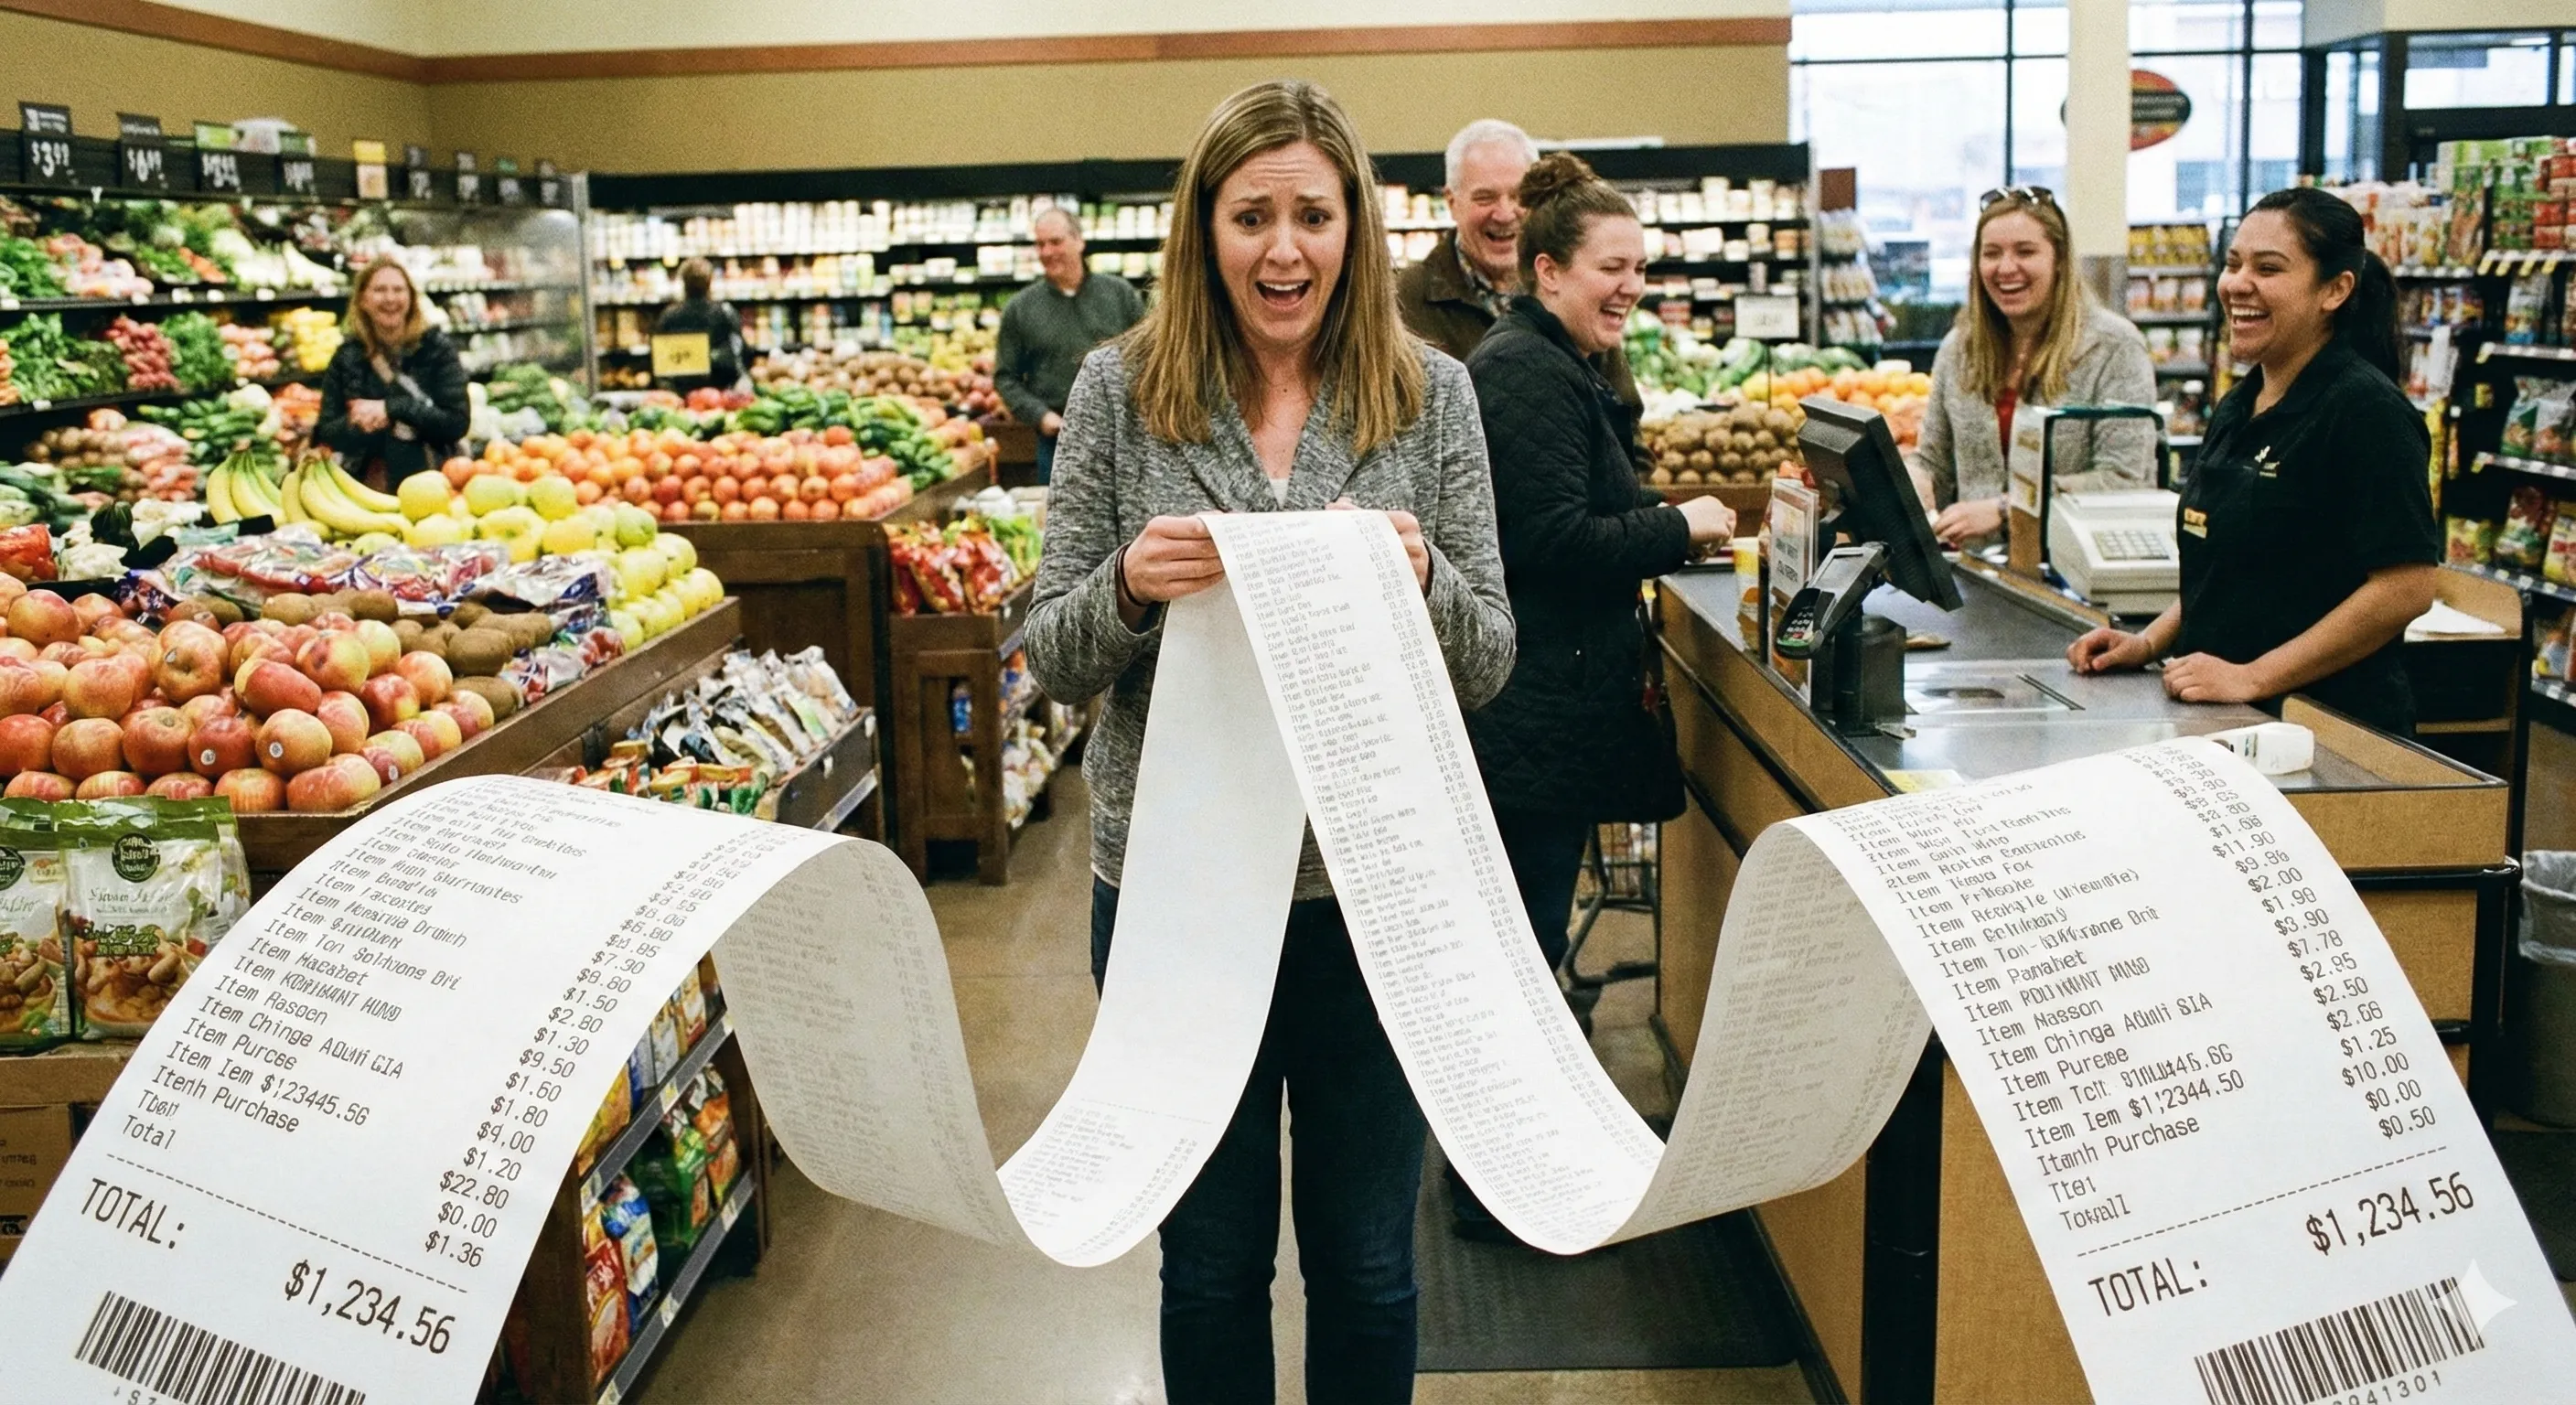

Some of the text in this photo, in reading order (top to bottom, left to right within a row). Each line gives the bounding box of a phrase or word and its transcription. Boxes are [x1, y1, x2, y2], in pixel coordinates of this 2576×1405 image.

[2212, 831, 2276, 858] $11.90
[315, 873, 356, 893] Item
[2248, 866, 2302, 893] $2.00
[296, 887, 339, 909] Item
[282, 903, 326, 926] Item
[1916, 917, 1964, 938] Item
[2274, 908, 2329, 936] $3.90
[264, 919, 307, 944] Item
[248, 938, 291, 962] Item
[1927, 936, 1977, 958] Item
[234, 955, 275, 981] Item
[1939, 955, 1988, 978] Item
[215, 975, 259, 1001] Item
[563, 987, 617, 1013] $1.50
[1952, 975, 2001, 1000] Item
[2313, 976, 2368, 1006] $2.50
[199, 996, 243, 1024] Item
[549, 1006, 603, 1033] $2.80
[1964, 999, 2012, 1023] Item
[183, 1017, 228, 1046] Item
[534, 1026, 589, 1055] $1.30
[1977, 1021, 2025, 1046] Item
[2340, 1026, 2397, 1057] $1.25
[166, 1040, 211, 1071] Item
[218, 1058, 253, 1085] Iem
[519, 1049, 575, 1078] $9.50
[1989, 1043, 2038, 1070] Item
[2342, 1052, 2409, 1088] $10.00
[506, 1072, 562, 1102] $1.60
[2001, 1069, 2051, 1096] Item
[2366, 1079, 2421, 1111] $0.00
[212, 1087, 299, 1132] Purchase
[491, 1096, 548, 1128] $1.80
[2012, 1095, 2063, 1121] Item
[122, 1114, 177, 1151] Total
[2024, 1122, 2076, 1149] Item
[2083, 1108, 2121, 1132] Iem
[2105, 1117, 2200, 1156] Purchase
[2378, 1105, 2436, 1140] $0.50
[464, 1147, 521, 1181] $1.20
[440, 1171, 509, 1209] $22.80
[437, 1201, 498, 1239] $0.00
[425, 1230, 484, 1268] $1.36
[2088, 1172, 2474, 1316] TOTAL: $1,234.56
[81, 1177, 456, 1355] TOTAL: $1,234.56
